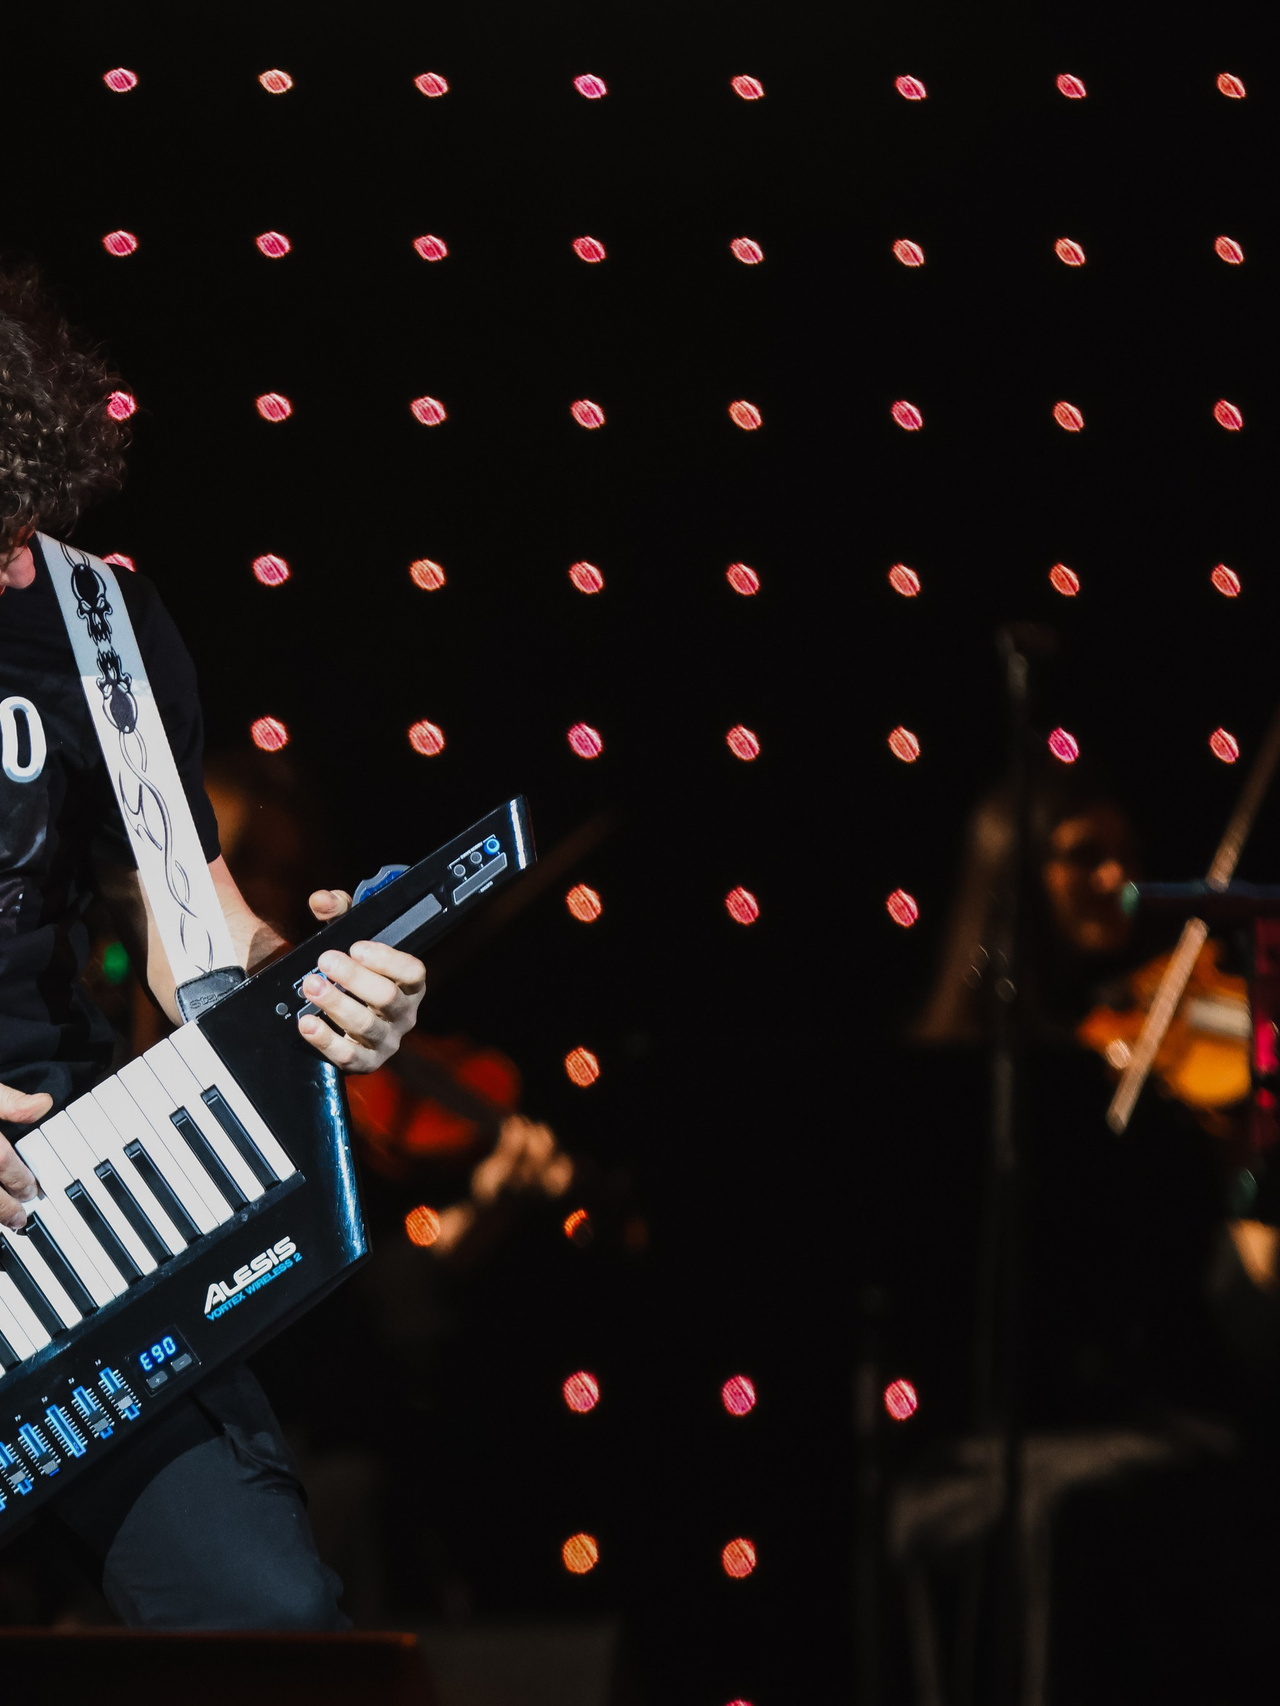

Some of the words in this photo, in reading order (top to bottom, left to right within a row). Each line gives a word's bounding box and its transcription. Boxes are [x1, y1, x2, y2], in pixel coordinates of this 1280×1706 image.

[206, 1291, 247, 1321] VORTEX
[244, 1258, 294, 1296] WIRELESS
[293, 1252, 303, 1263] 2
[139, 1335, 178, 1372] E90
